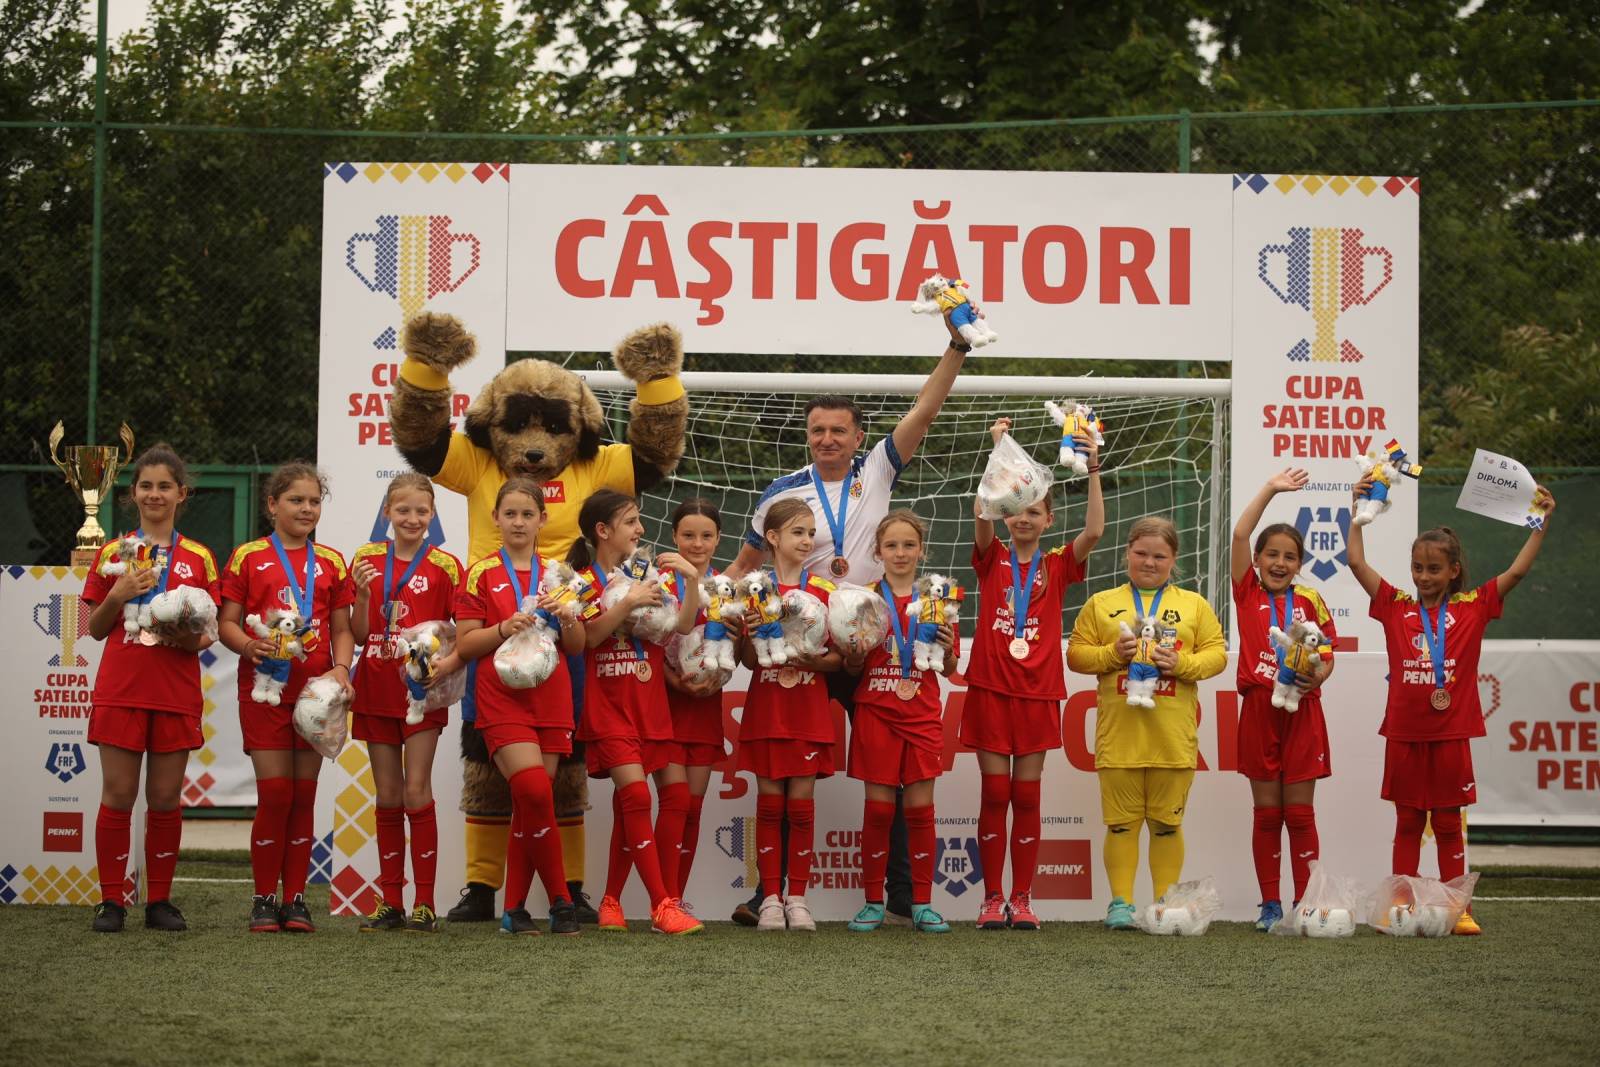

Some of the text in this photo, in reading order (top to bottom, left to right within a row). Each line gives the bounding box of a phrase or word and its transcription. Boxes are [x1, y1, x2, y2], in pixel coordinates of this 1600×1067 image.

[1286, 375, 1364, 400] CUPA
[1263, 404, 1386, 430] SATELOR
[1302, 483, 1342, 491] GANIZAT
[1311, 532, 1338, 550] FRF
[597, 662, 637, 677] PENN
[47, 674, 88, 687] CUPA
[1509, 721, 1598, 752] SATE
[58, 756, 74, 768] FRF
[1538, 760, 1600, 790] PEN
[826, 831, 863, 848] CUP
[810, 852, 864, 868] ATELO
[944, 857, 968, 872] FRF
[808, 872, 865, 888] PENN
